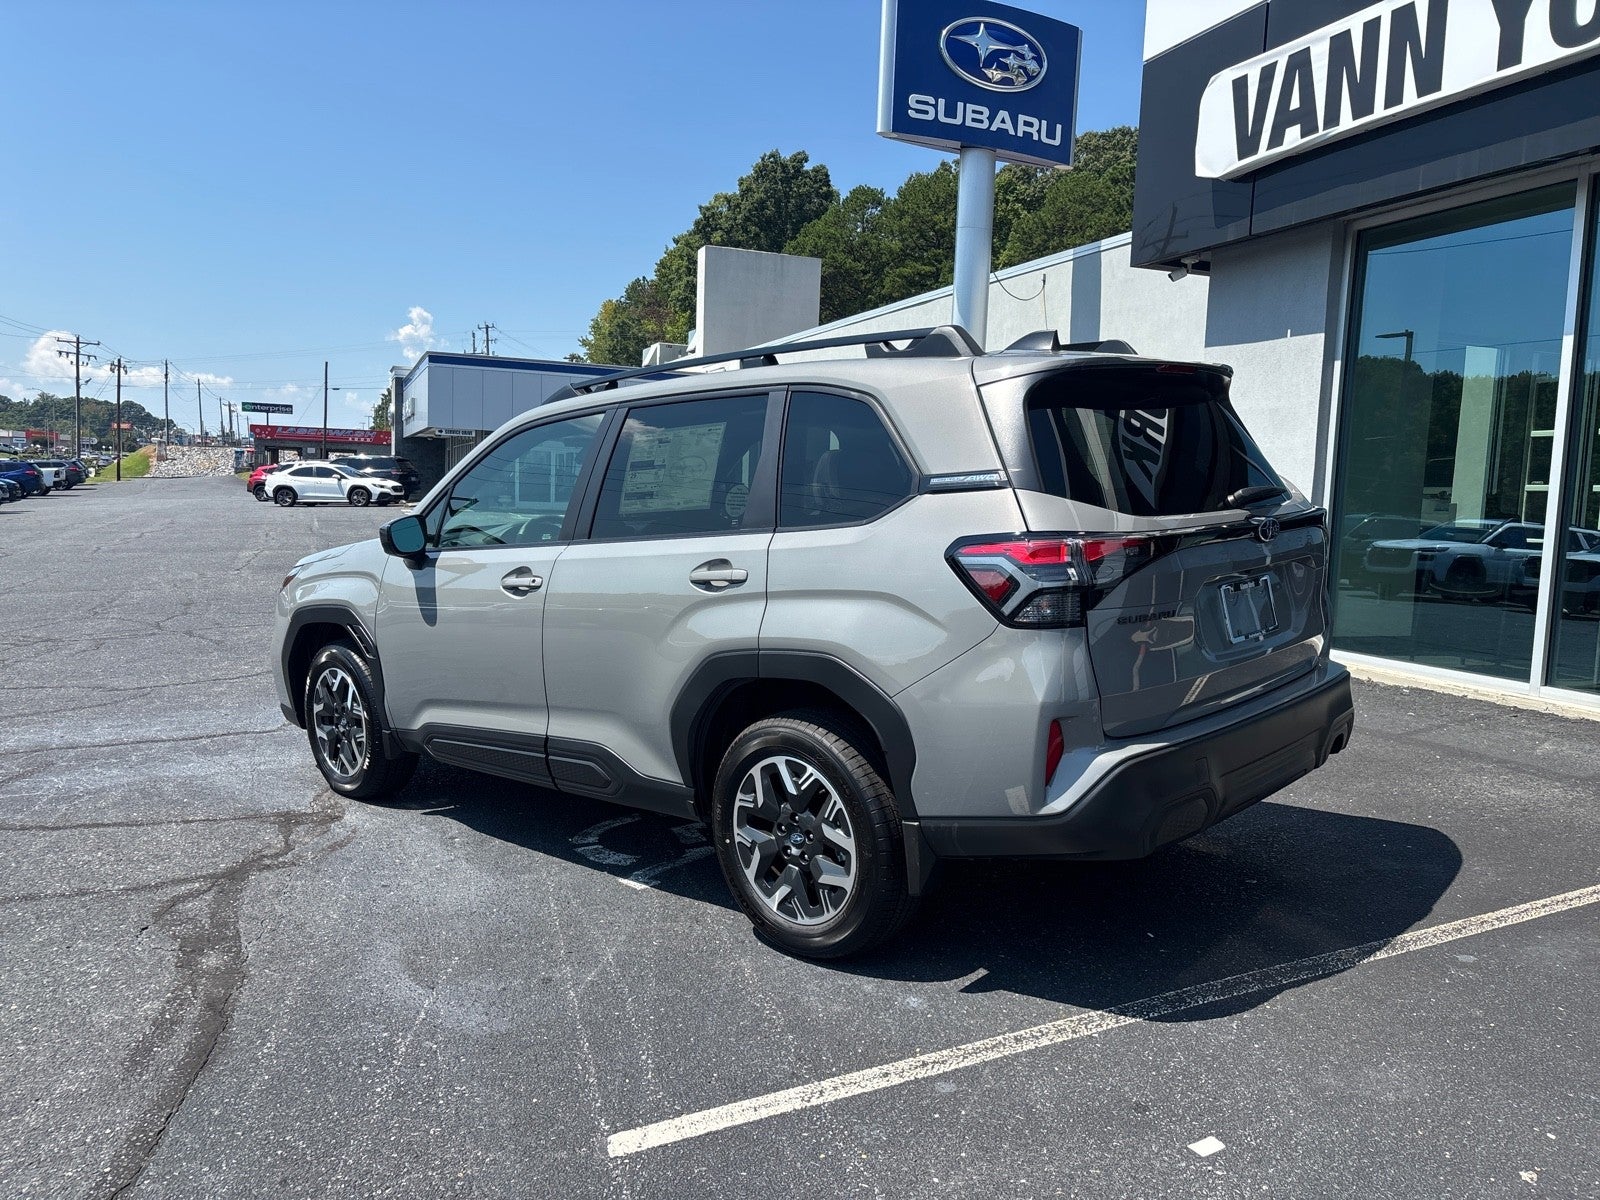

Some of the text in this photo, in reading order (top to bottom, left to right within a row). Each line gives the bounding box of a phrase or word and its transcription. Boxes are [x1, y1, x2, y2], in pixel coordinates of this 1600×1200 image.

[1231, 0, 1449, 161] VANN
[908, 93, 1062, 147] SUBARU
[276, 427, 376, 438] LASERWASH
[1117, 609, 1177, 625] SUBARU
